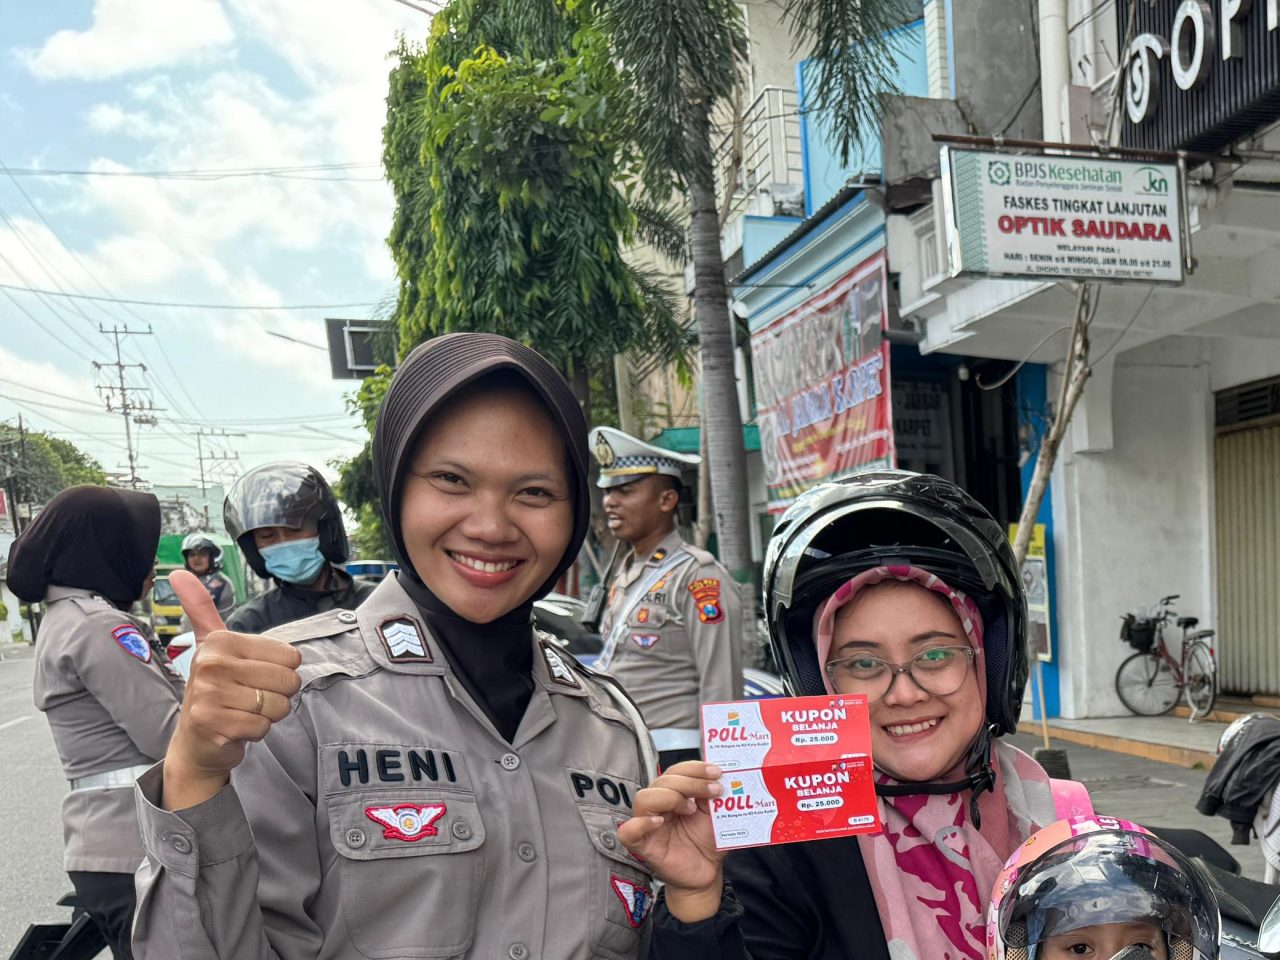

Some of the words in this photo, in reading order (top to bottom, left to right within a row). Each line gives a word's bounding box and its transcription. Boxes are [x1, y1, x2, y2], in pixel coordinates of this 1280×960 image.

[1014, 162, 1047, 179] BPJS
[1049, 164, 1122, 184] Kesehatan
[1004, 196, 1049, 211] FASKES
[1053, 198, 1104, 214] TINGKAT
[1107, 201, 1167, 217] LANJUTAN
[998, 215, 1066, 237] OPTIK
[1072, 219, 1173, 242] SAUDARA
[781, 708, 848, 723] KUPON
[707, 726, 748, 743] POLL
[748, 732, 770, 742] Mart
[791, 722, 838, 732] BELANJA
[795, 736, 808, 744] Rp.
[809, 735, 834, 743] 25.000
[337, 748, 457, 787] HENI
[784, 771, 850, 789] KUPON
[796, 785, 843, 797] BELANJA
[713, 795, 754, 812] POLL
[754, 799, 776, 809] Mart
[801, 801, 814, 809] Rp.
[814, 799, 841, 808] 25.000
